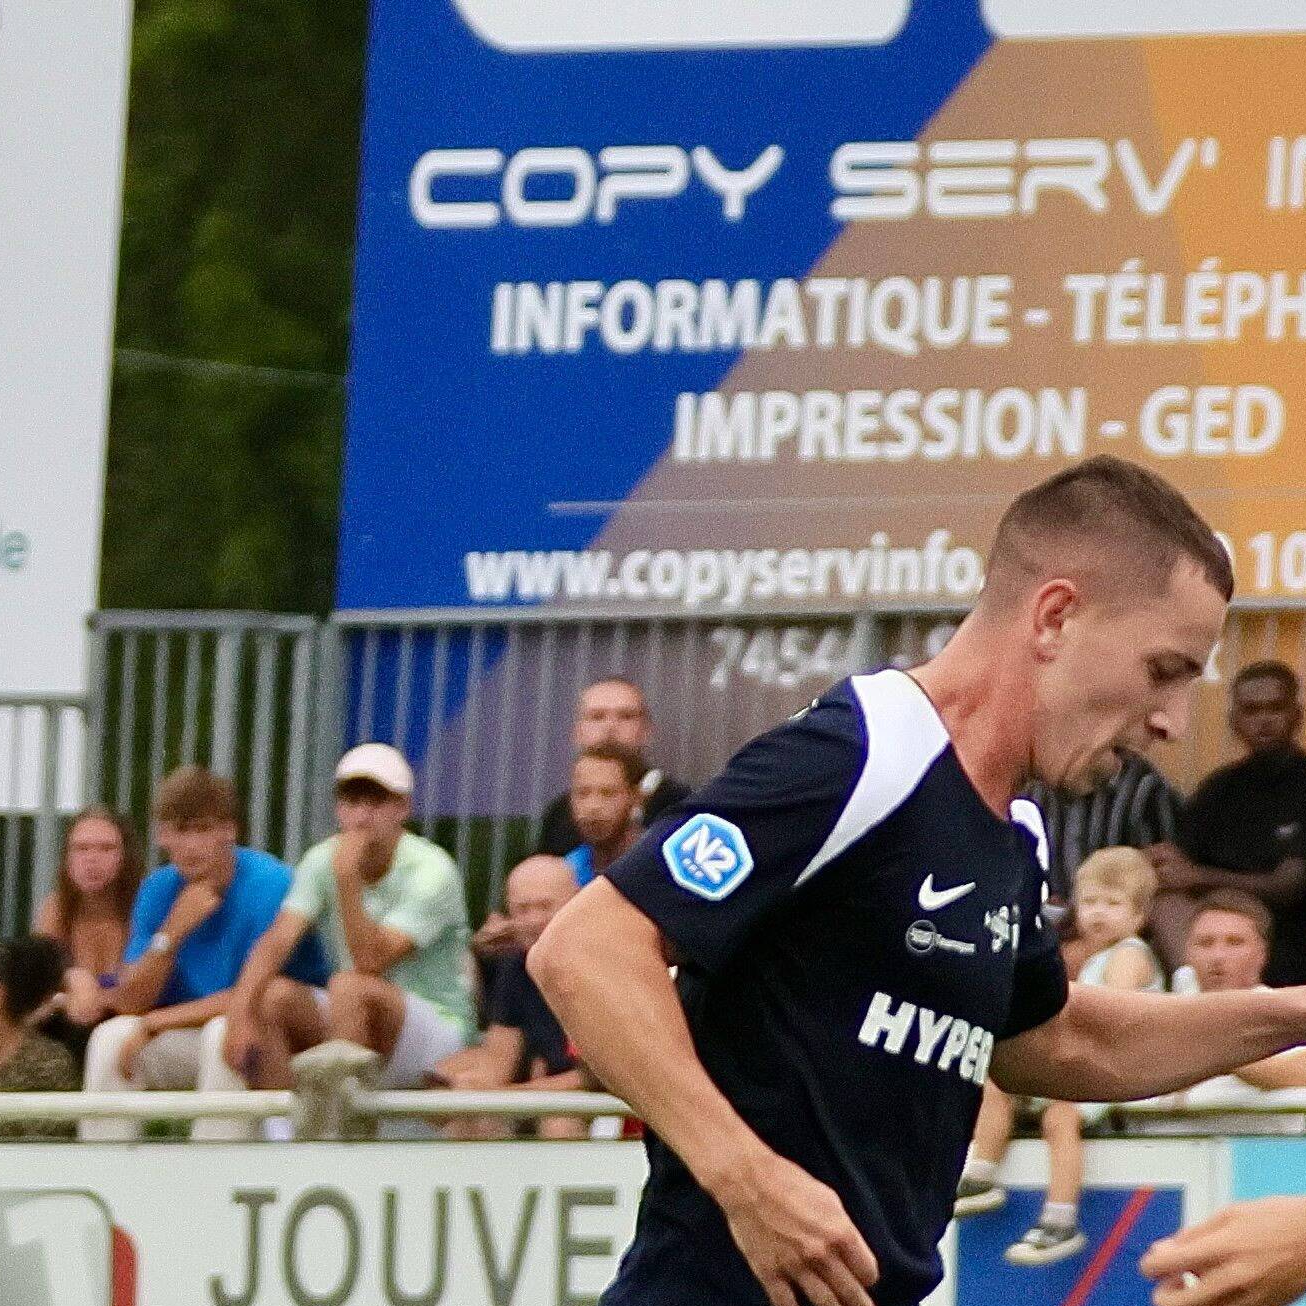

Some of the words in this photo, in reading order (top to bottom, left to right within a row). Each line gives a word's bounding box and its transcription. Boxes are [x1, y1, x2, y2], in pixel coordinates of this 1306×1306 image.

[410, 143, 784, 229] COPY
[829, 136, 1217, 222] SERV'
[492, 274, 1011, 355] INFORMATIQUE
[673, 385, 1084, 462] IMPRESSION
[1139, 385, 1285, 457] GED
[681, 824, 737, 884] N2
